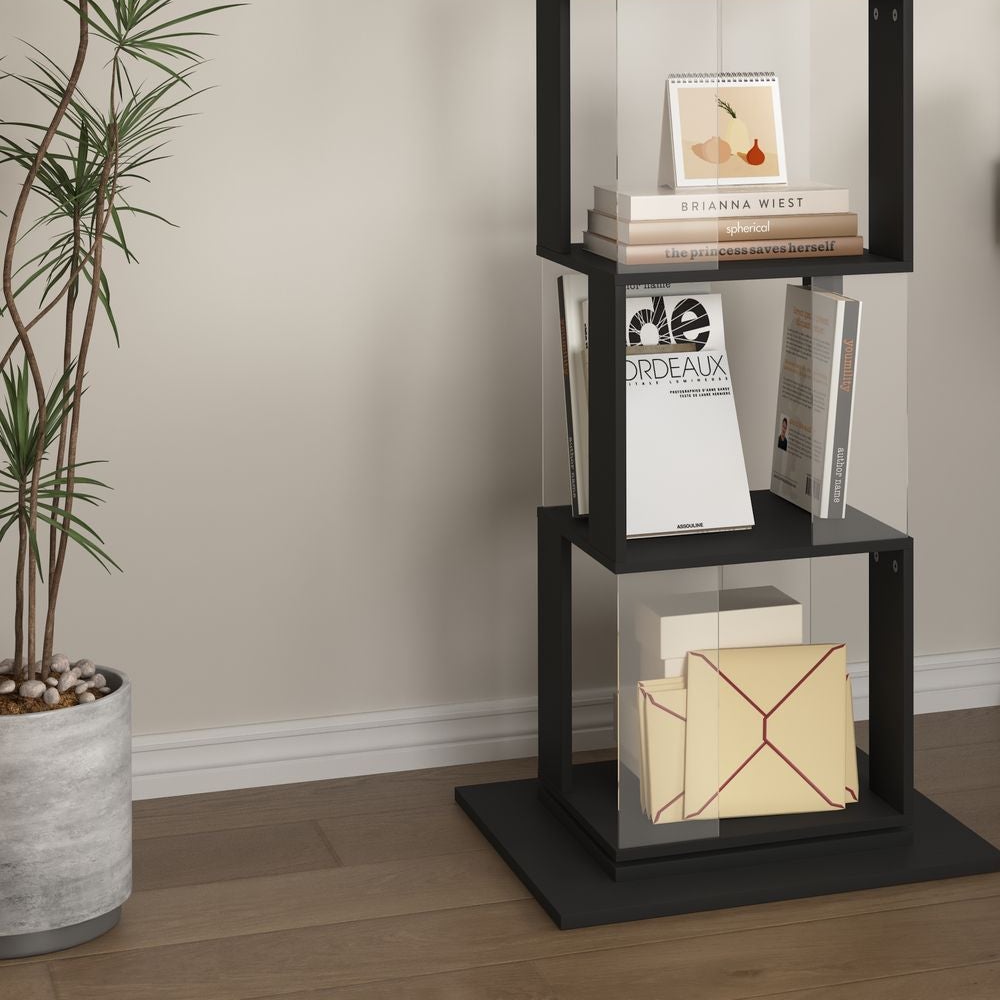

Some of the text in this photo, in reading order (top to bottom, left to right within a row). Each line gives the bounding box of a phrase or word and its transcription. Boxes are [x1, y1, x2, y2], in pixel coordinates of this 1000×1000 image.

[681, 197, 804, 211] BRIANNA WIEST
[726, 220, 770, 236] spherical
[665, 240, 836, 260] the princess saves herself
[626, 355, 727, 382] ORDEAUX
[833, 447, 844, 503] author name
